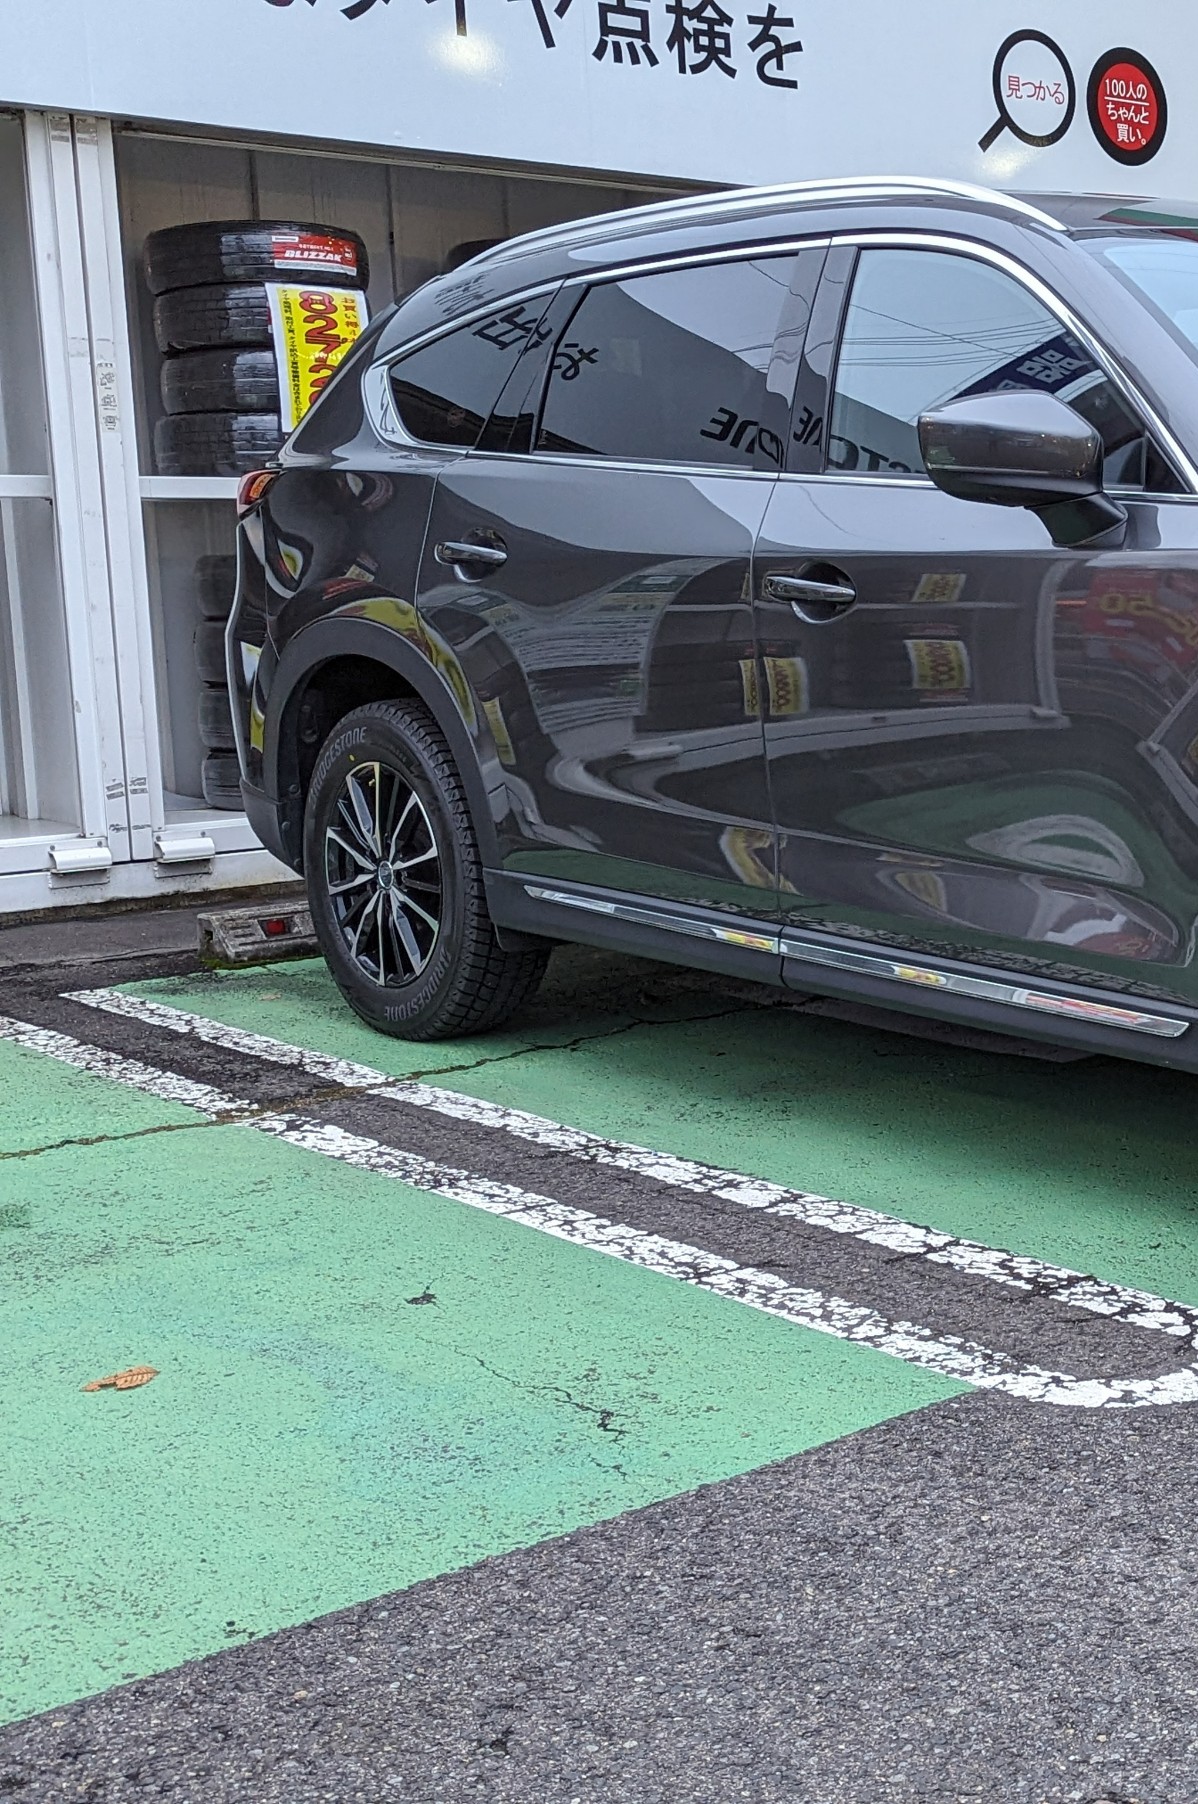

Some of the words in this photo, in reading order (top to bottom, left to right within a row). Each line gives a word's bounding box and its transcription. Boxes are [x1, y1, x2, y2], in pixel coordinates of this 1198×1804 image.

[1006, 75, 1065, 105] 見つかる
[1105, 79, 1148, 100] 100人の
[1106, 102, 1150, 125] ちゃんと
[1116, 123, 1147, 146] 買い。
[284, 249, 343, 262] BLIZZAK
[310, 726, 368, 811] BRIDGESTONE
[384, 944, 452, 1022] BRIDGESTONE
